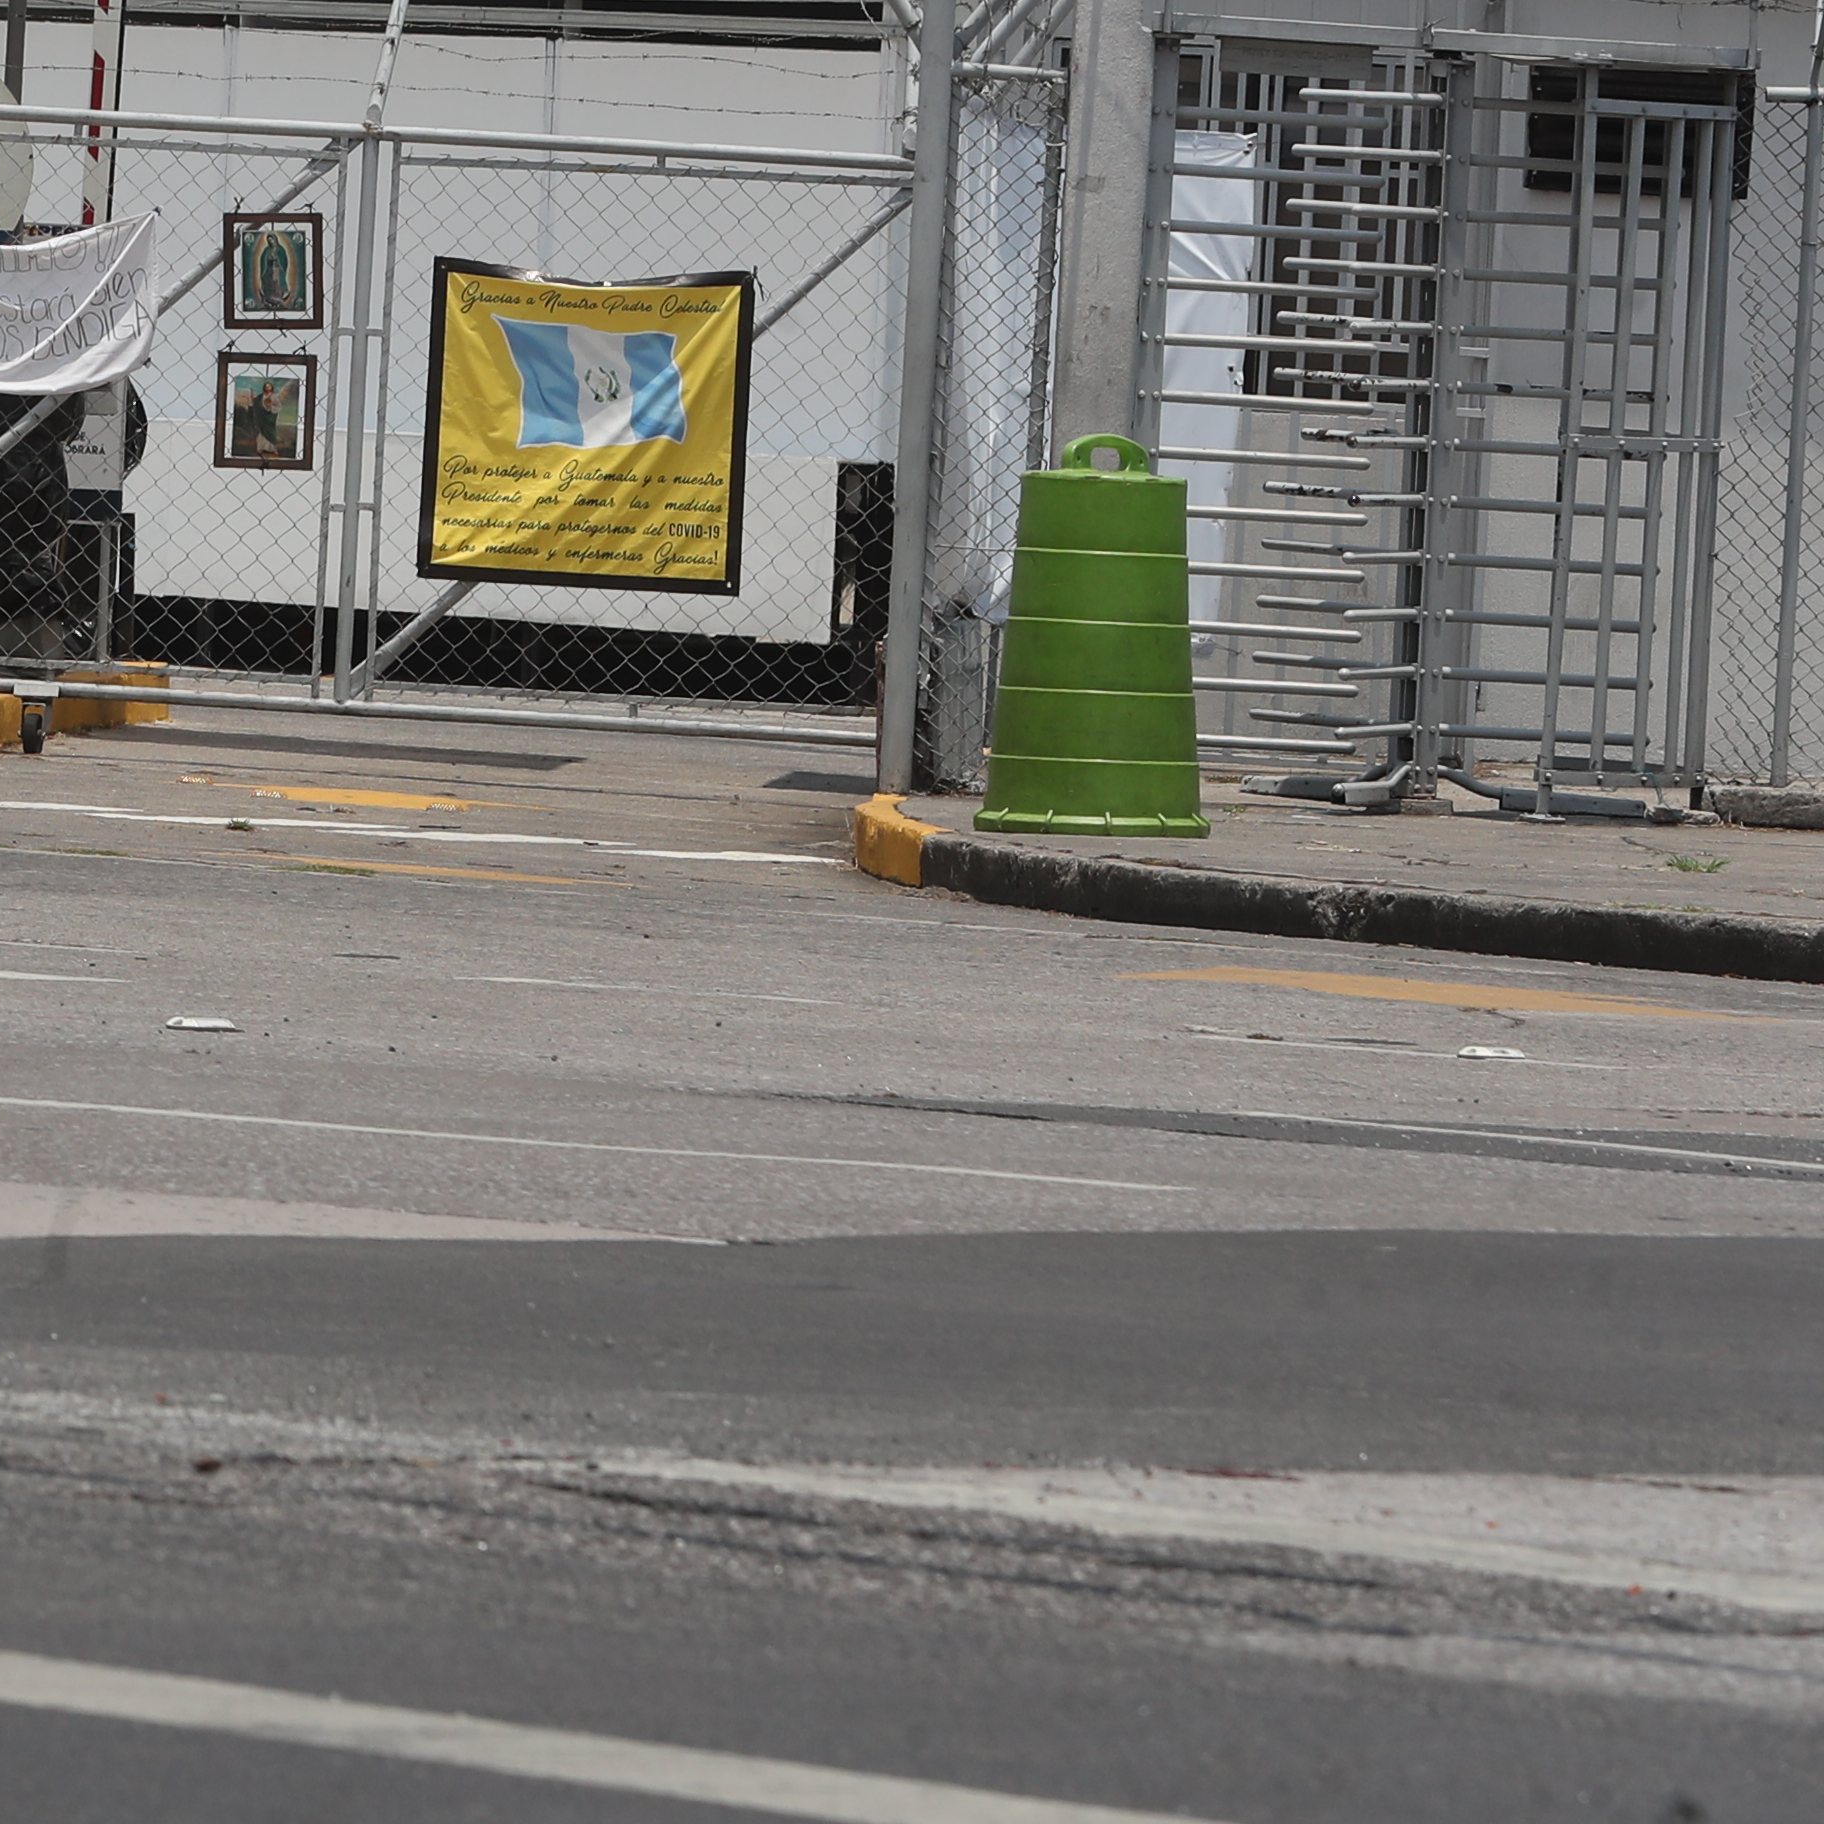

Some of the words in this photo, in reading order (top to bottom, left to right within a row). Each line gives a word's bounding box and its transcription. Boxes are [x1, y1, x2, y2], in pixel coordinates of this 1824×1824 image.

[460, 281, 522, 314] Gracias
[526, 297, 536, 305] a
[539, 289, 599, 311] Nuestro
[602, 295, 653, 316] Padre
[659, 294, 725, 319] Celestial
[64, 443, 107, 455] OBRARÁ
[443, 454, 479, 481] Por
[483, 464, 538, 484] protejer
[543, 471, 552, 479] a
[558, 459, 638, 492] Guatemala
[643, 474, 652, 487] y
[657, 475, 667, 484] a
[673, 473, 724, 487] nuestro
[442, 481, 522, 505] Presidente
[533, 496, 559, 509] por
[573, 495, 616, 508] tomar
[629, 495, 650, 510] las
[664, 499, 722, 514] medidas
[442, 516, 513, 529] necesarias
[518, 520, 551, 535] para
[555, 518, 637, 541] protegernos
[642, 521, 664, 537] del
[668, 522, 721, 540] COVID-19
[439, 543, 449, 552] a
[457, 539, 477, 553] los
[546, 549, 557, 560] y
[565, 546, 644, 563] enfermeras
[653, 541, 719, 575] Gracias!
